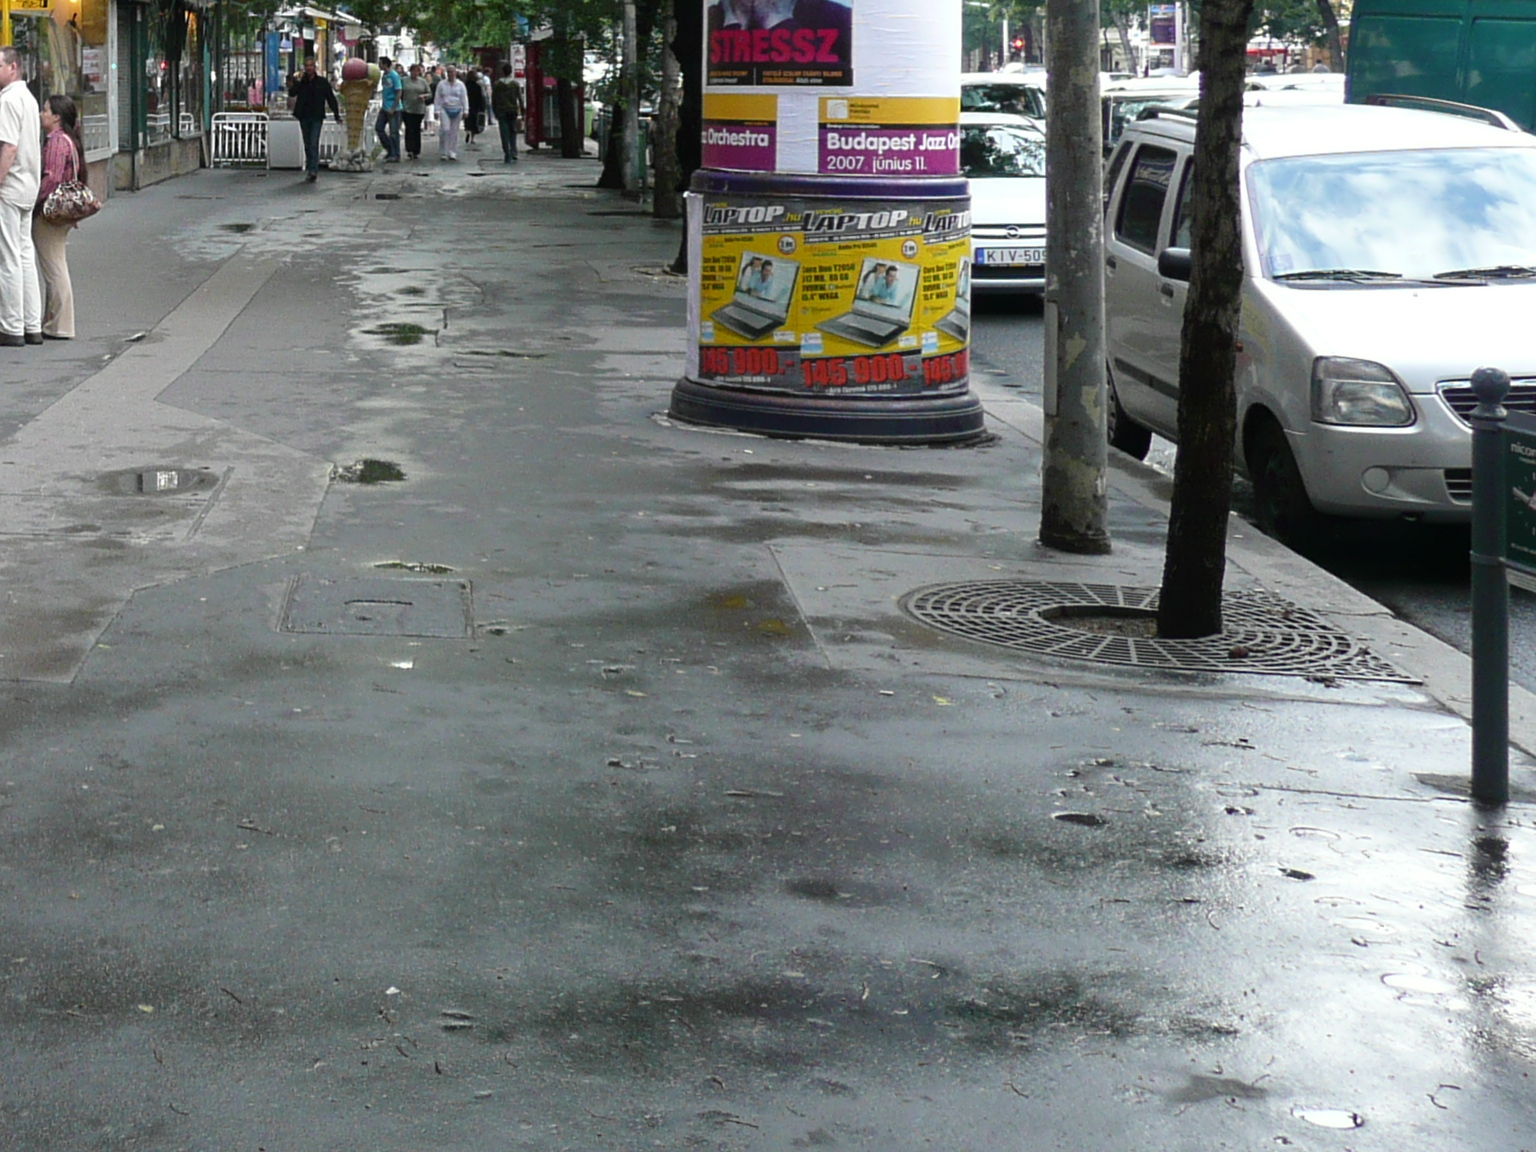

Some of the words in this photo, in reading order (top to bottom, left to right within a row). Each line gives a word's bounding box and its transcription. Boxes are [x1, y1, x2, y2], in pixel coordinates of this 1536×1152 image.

[709, 28, 840, 64] STRESSZ
[708, 128, 769, 147] Orchestra
[826, 131, 917, 155] Budapest
[918, 132, 947, 151] Jazz
[701, 347, 731, 376] 145
[800, 357, 848, 388] 145
[852, 353, 918, 385] 900.-
[922, 355, 952, 386] 145
